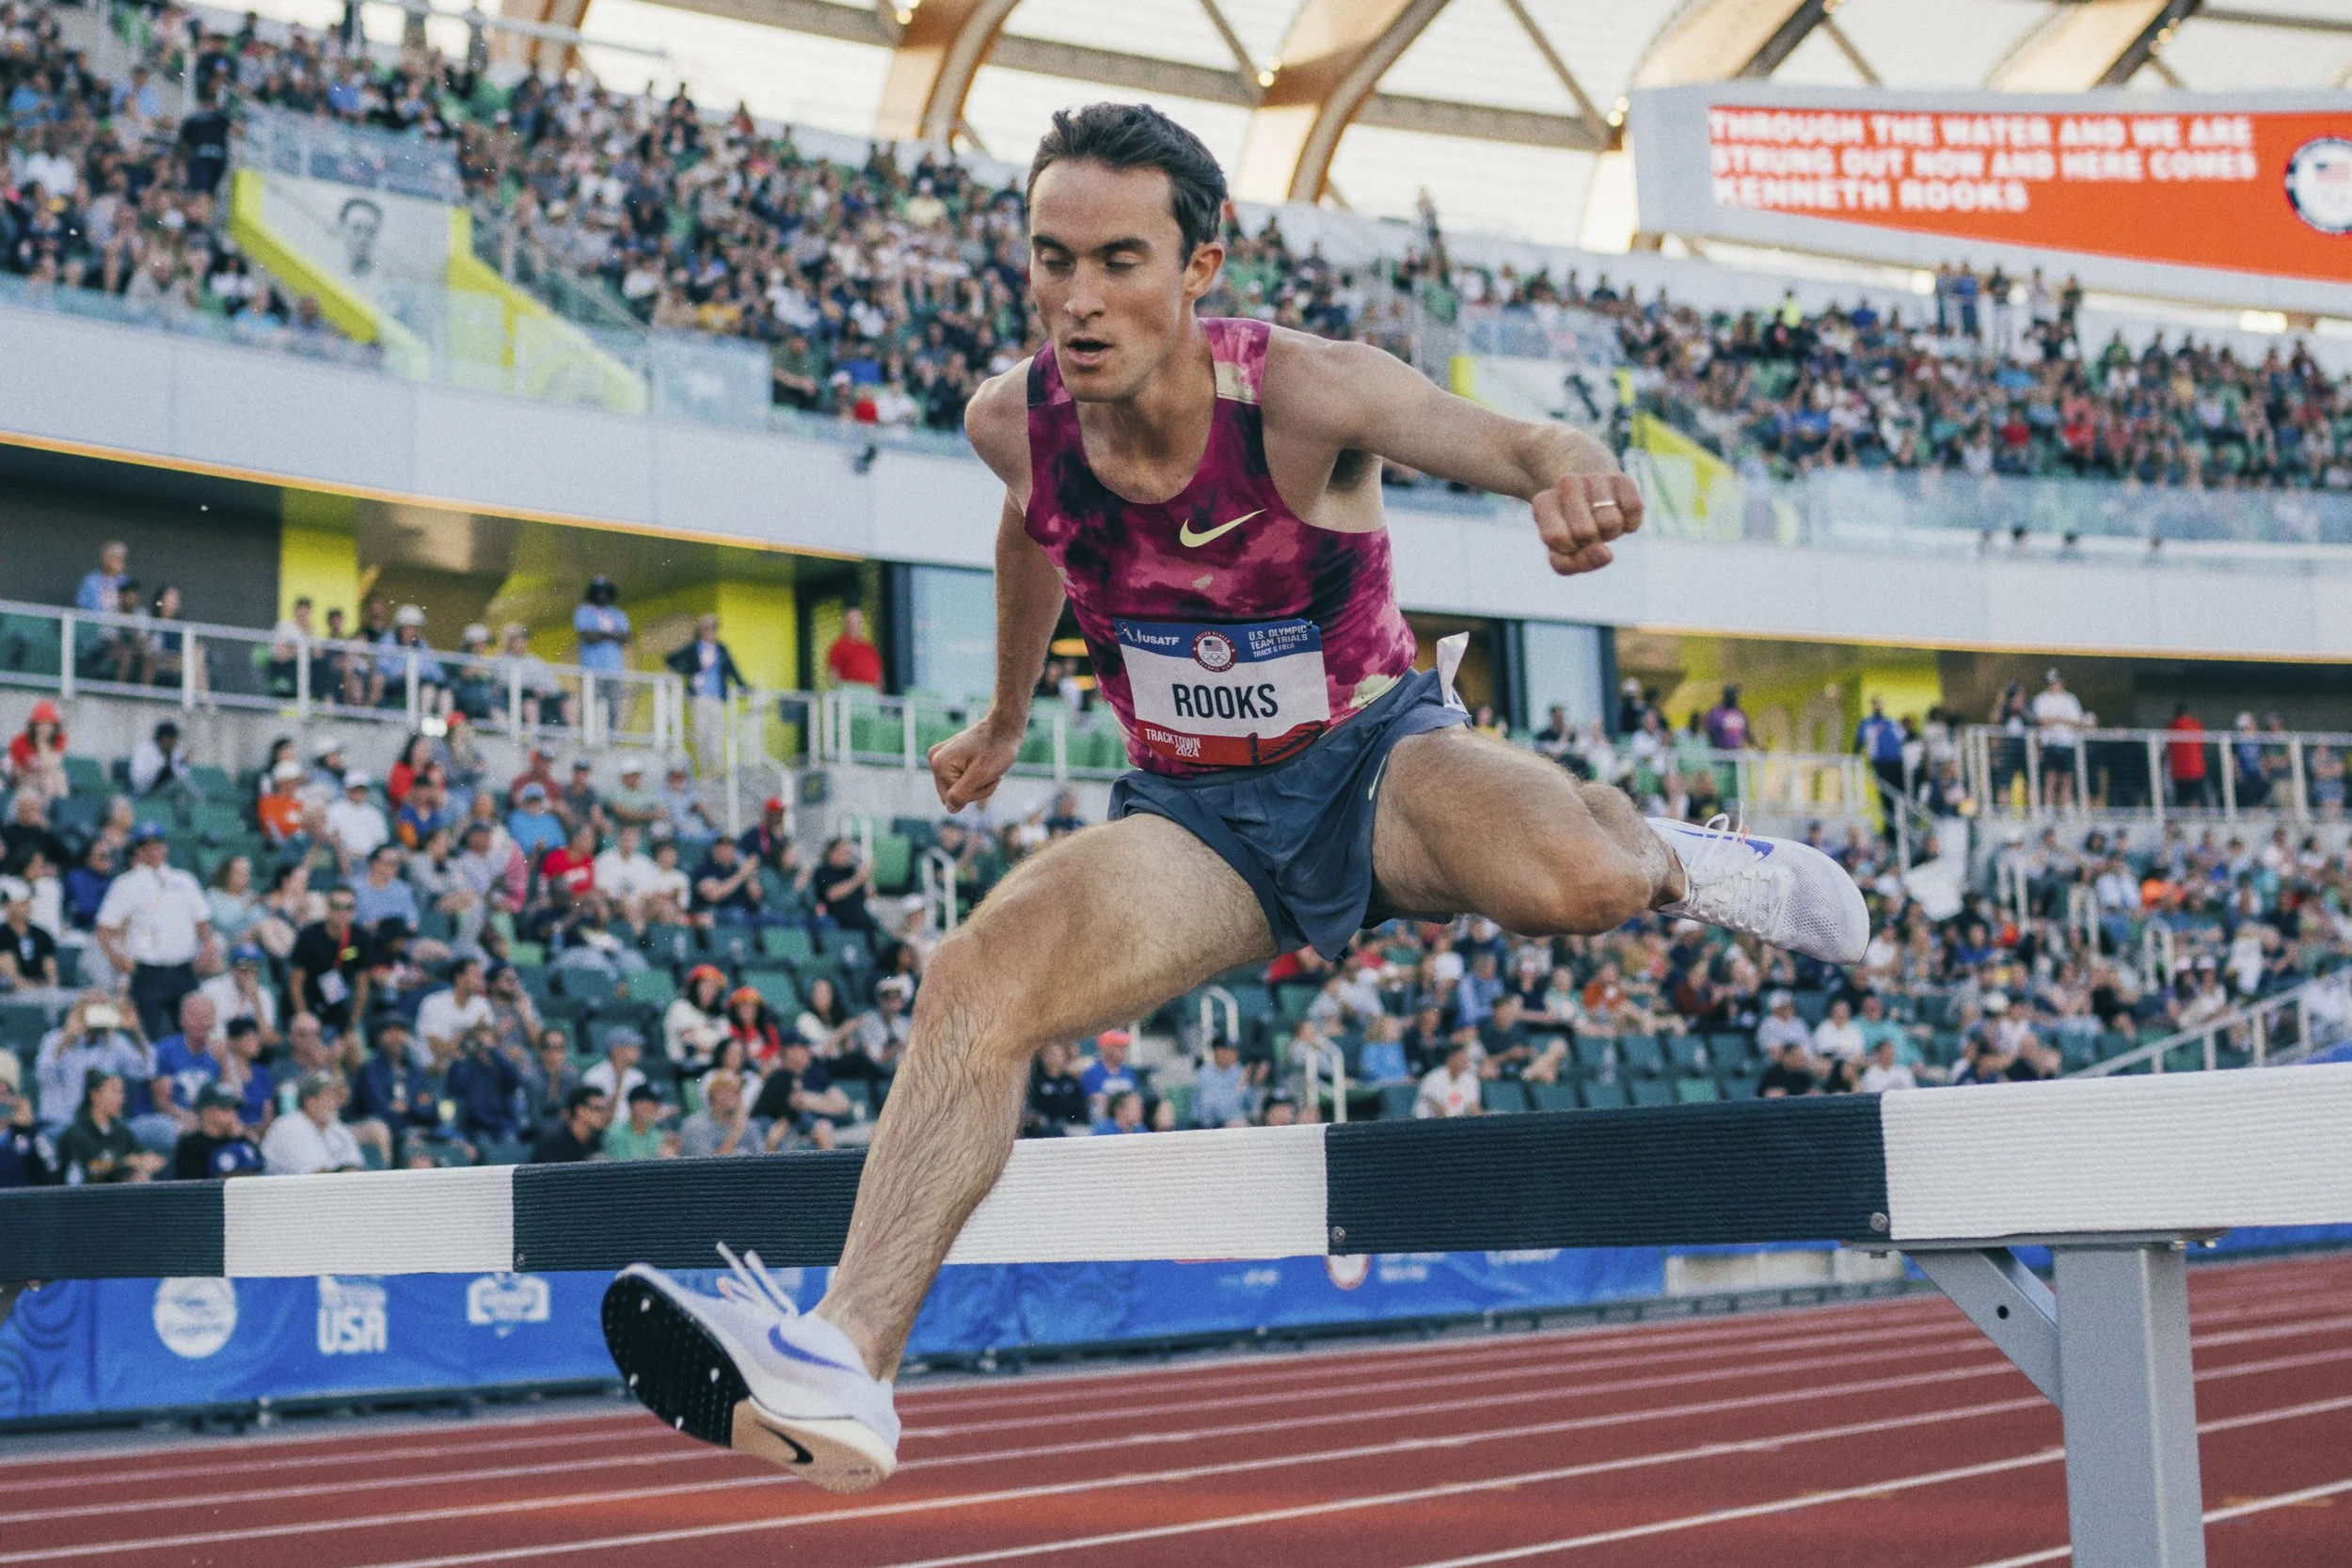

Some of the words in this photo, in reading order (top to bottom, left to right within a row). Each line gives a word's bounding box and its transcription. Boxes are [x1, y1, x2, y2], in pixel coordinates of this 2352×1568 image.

[1709, 112, 1863, 143] THROUGH
[1871, 115, 1933, 144] THE
[1941, 118, 2052, 146] WATER
[2058, 118, 2126, 147] AND
[2130, 118, 2179, 147] WE
[2188, 117, 2252, 147] ARE
[1710, 146, 1834, 175] STRUNG
[1841, 148, 1903, 178] OUT
[1912, 150, 1984, 179] NOW
[1991, 150, 2055, 180] AND
[2060, 151, 2143, 181] HERE
[2149, 150, 2258, 181] COMES
[1712, 176, 1890, 209] KENNETH
[1899, 179, 2029, 212] ROOKS
[1142, 634, 1180, 645] USATF
[1248, 630, 1266, 641] U.S.
[1268, 625, 1308, 638] OLYMPIC
[1249, 638, 1275, 651] TEAM
[1277, 633, 1309, 644] TRIALS
[1252, 647, 1272, 658] TRACK
[1279, 642, 1295, 651] FIELD
[1171, 683, 1279, 720] ROOKS
[1175, 743, 1200, 758] 2024
[318, 1308, 387, 1354] USA
